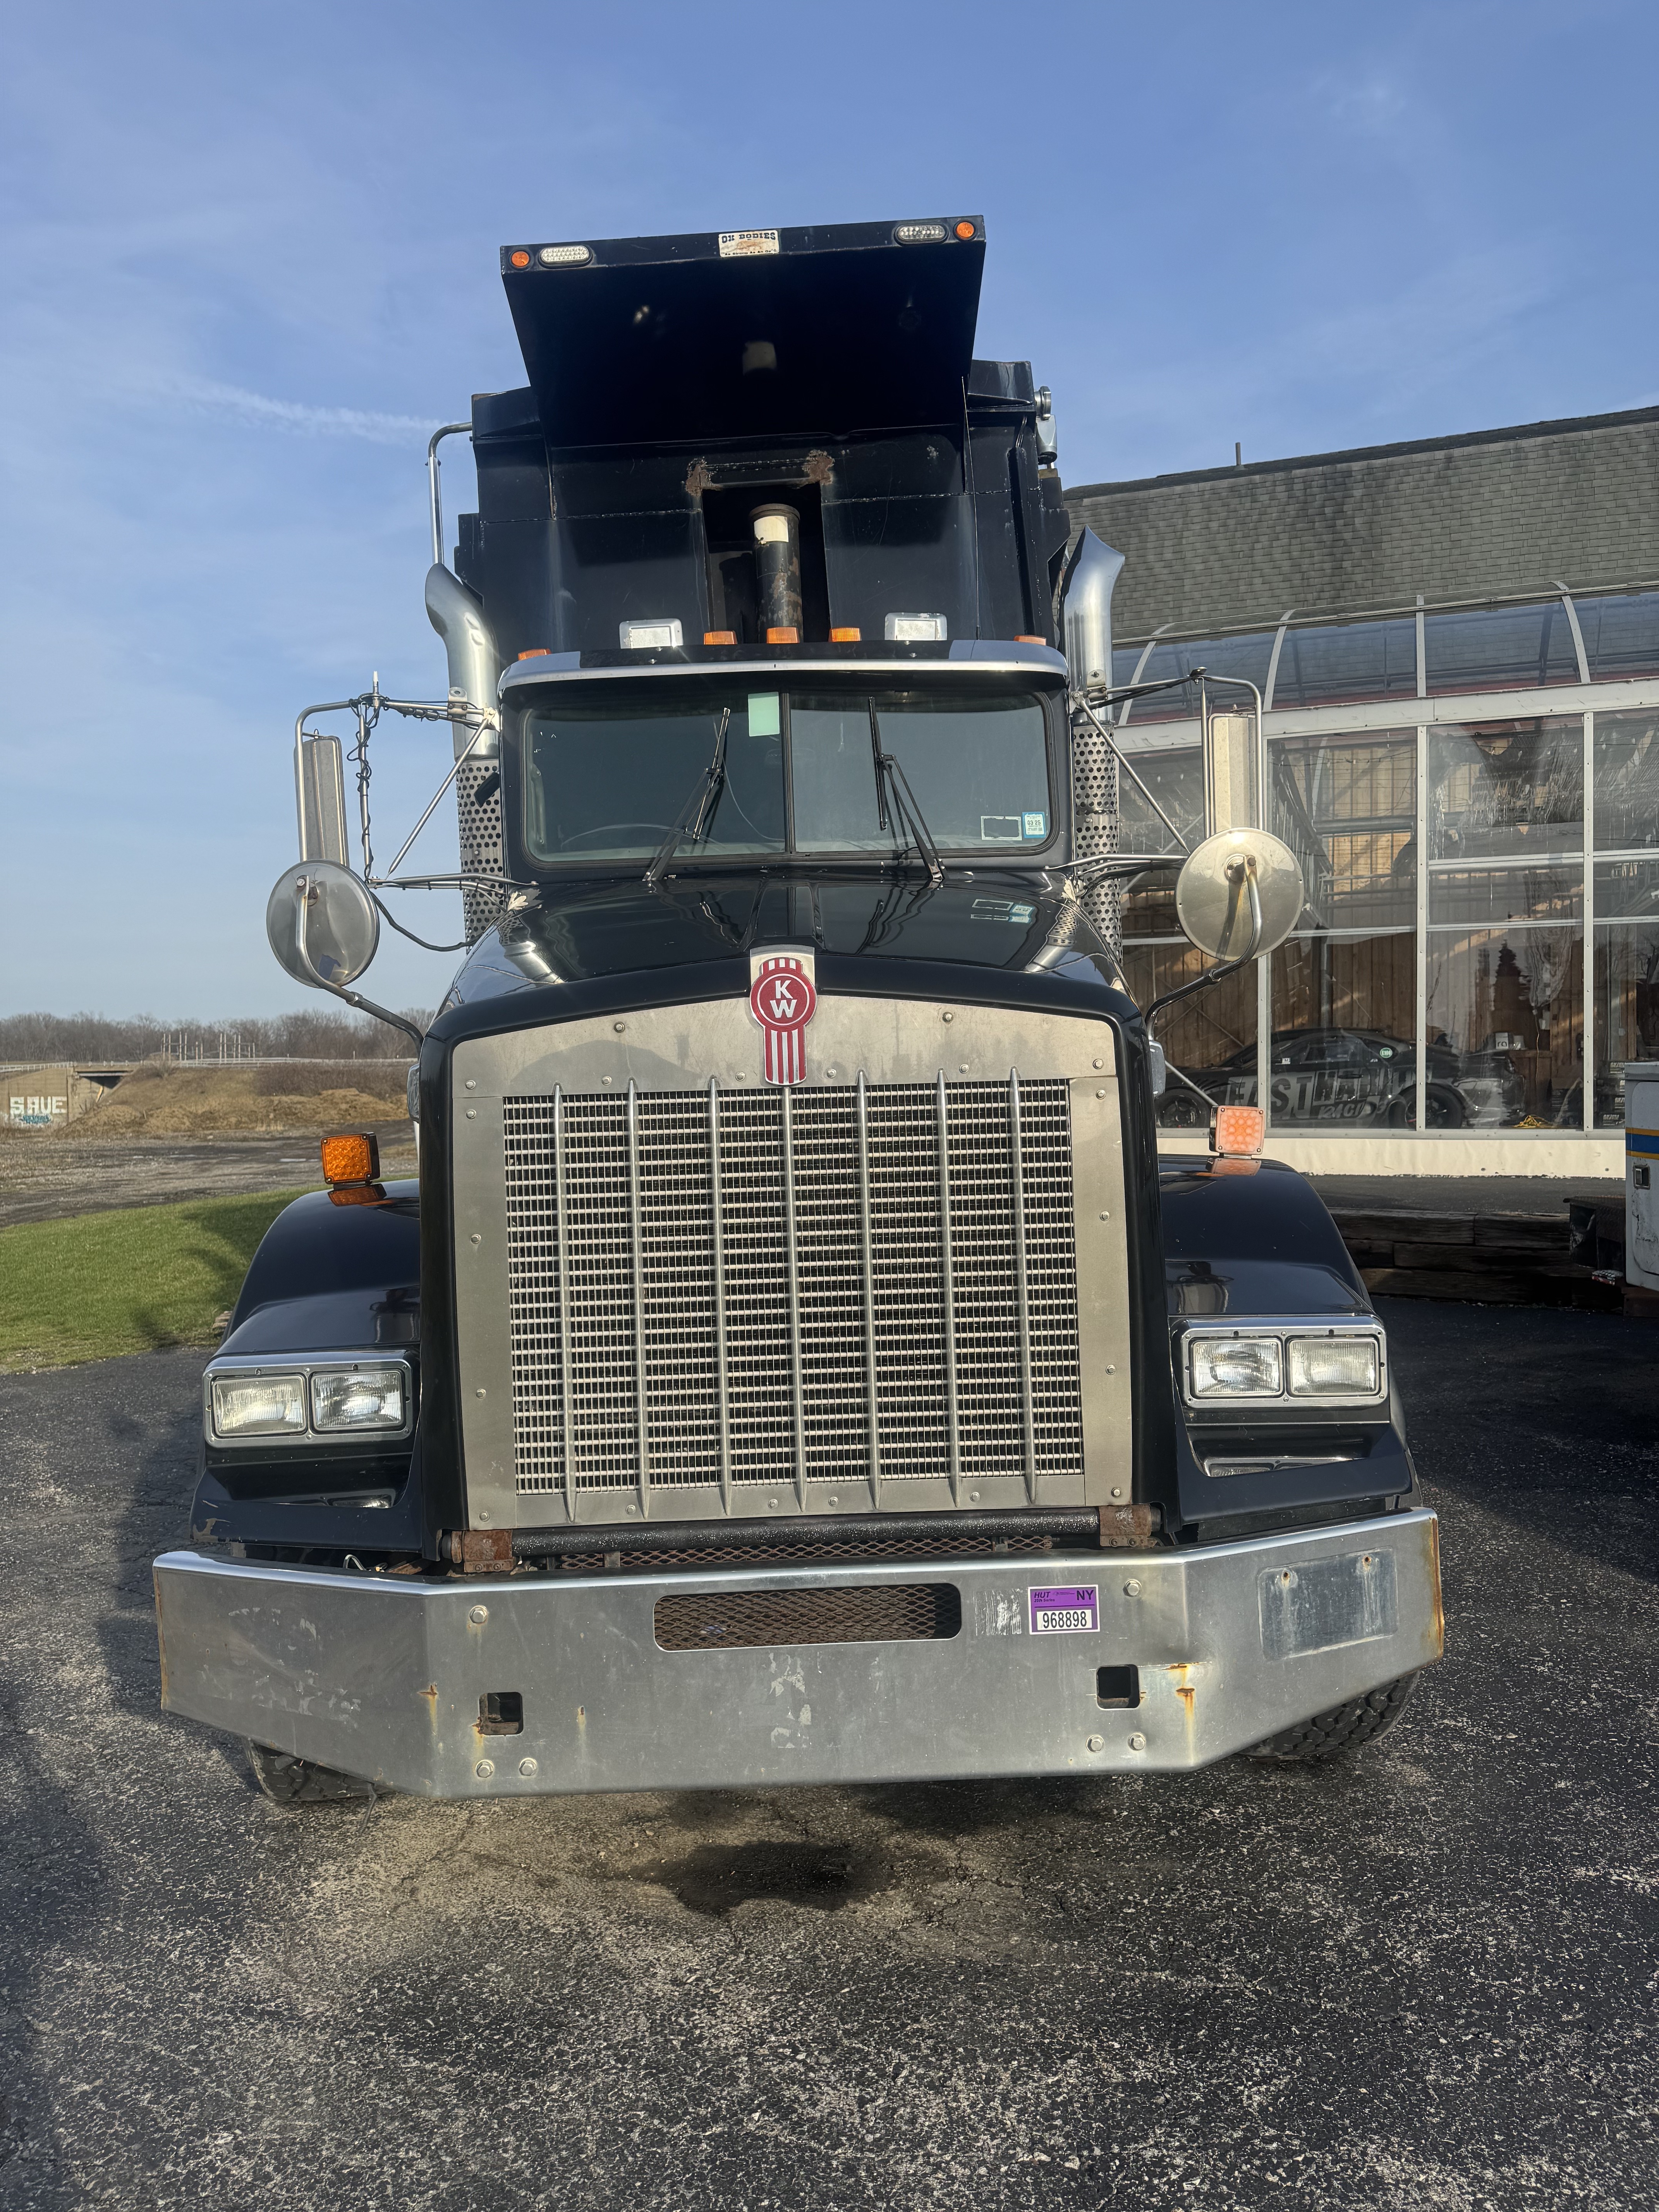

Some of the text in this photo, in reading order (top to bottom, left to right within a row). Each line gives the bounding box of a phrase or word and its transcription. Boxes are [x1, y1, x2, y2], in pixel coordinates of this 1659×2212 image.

[721, 232, 776, 244] OX BODIES
[775, 980, 793, 999] K
[770, 999, 797, 1018] W
[10, 1096, 67, 1115] SAVE
[1076, 1590, 1094, 1601] NY
[1042, 1611, 1087, 1628] 968898
